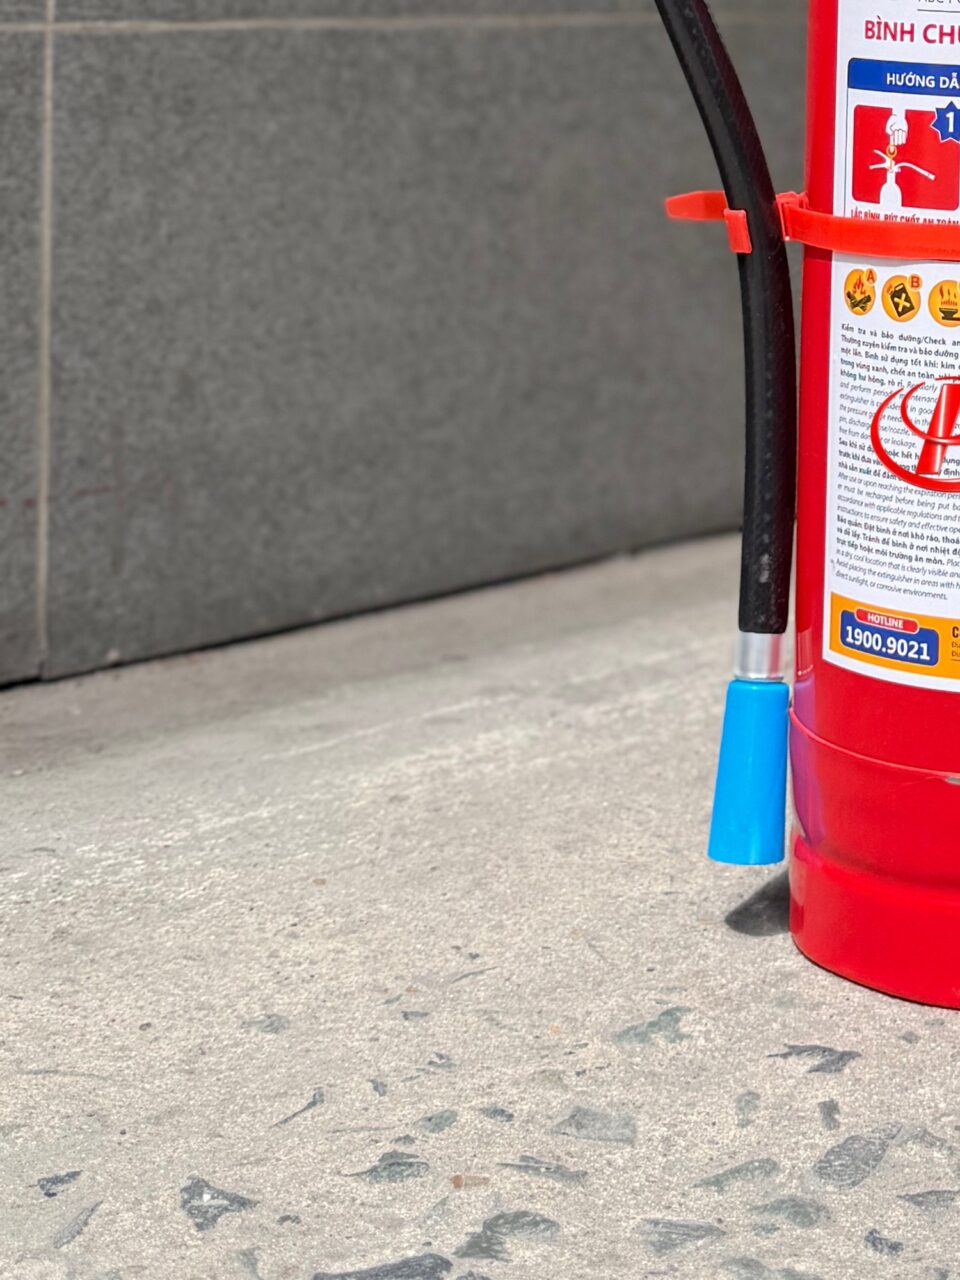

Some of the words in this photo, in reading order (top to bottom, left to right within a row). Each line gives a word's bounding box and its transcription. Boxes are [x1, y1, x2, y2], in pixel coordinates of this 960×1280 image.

[865, 16, 915, 42] BÌNH
[887, 72, 935, 88] HƯỚNG
[946, 112, 954, 133] 1
[866, 270, 875, 282] A
[910, 276, 920, 288] B
[941, 361, 955, 369] kim
[867, 613, 904, 629] HOTLINE
[846, 626, 931, 661] 1900.9021
